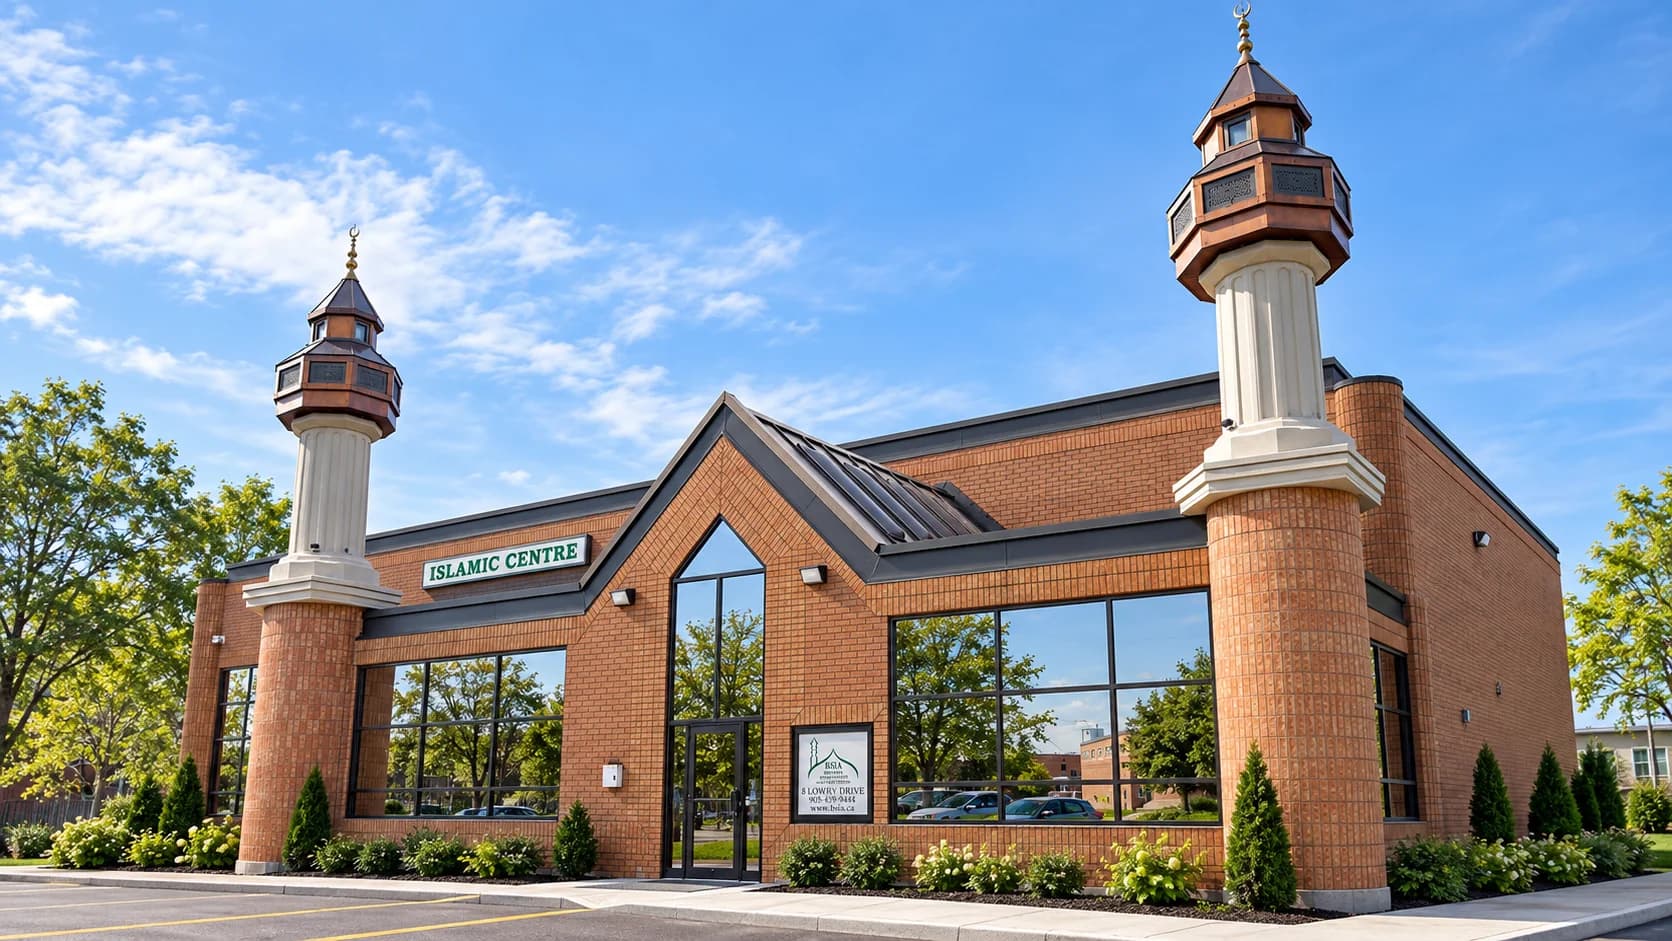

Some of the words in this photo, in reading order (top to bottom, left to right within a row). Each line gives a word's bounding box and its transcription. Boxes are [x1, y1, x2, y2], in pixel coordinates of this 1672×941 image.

[429, 556, 500, 581] ISLAMIC
[505, 543, 578, 569] CENTRE
[807, 787, 837, 795] LOWRY
[839, 787, 865, 795] DRIVE
